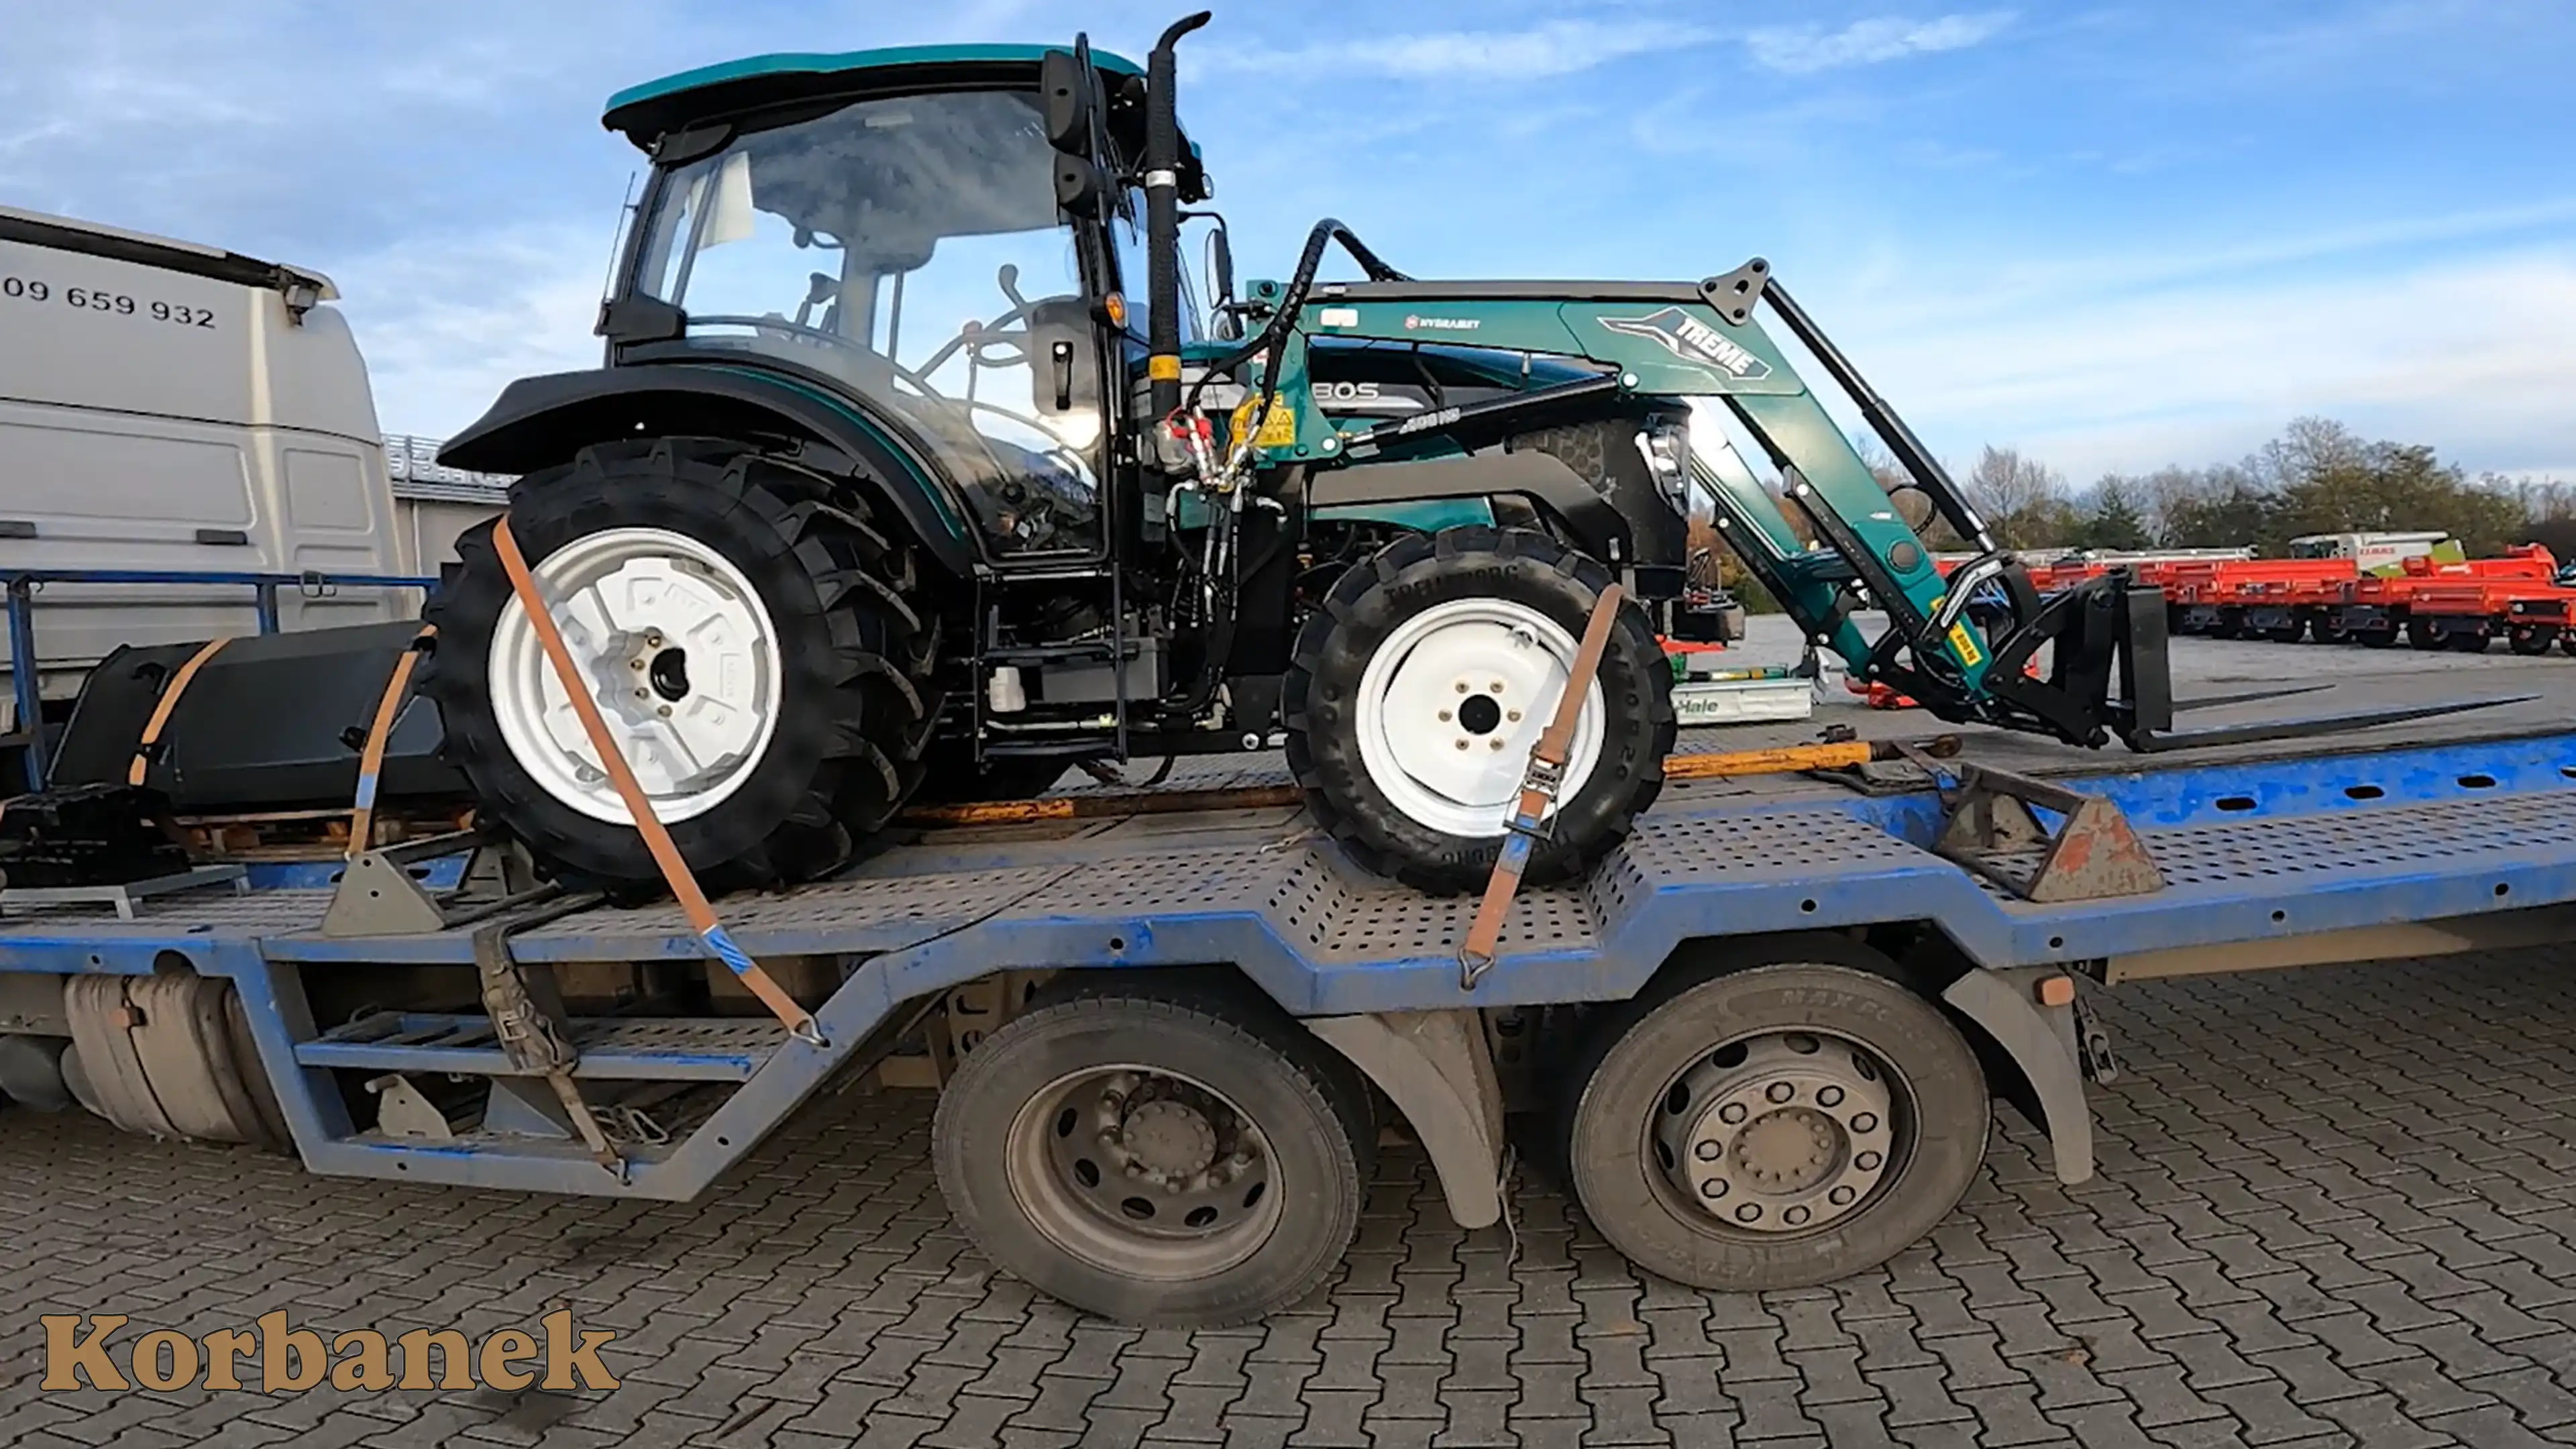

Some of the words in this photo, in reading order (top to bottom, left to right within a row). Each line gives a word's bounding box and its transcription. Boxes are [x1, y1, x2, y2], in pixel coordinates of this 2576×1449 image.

[3, 277, 48, 301] 09
[67, 288, 134, 315] 659
[151, 301, 215, 329] 932
